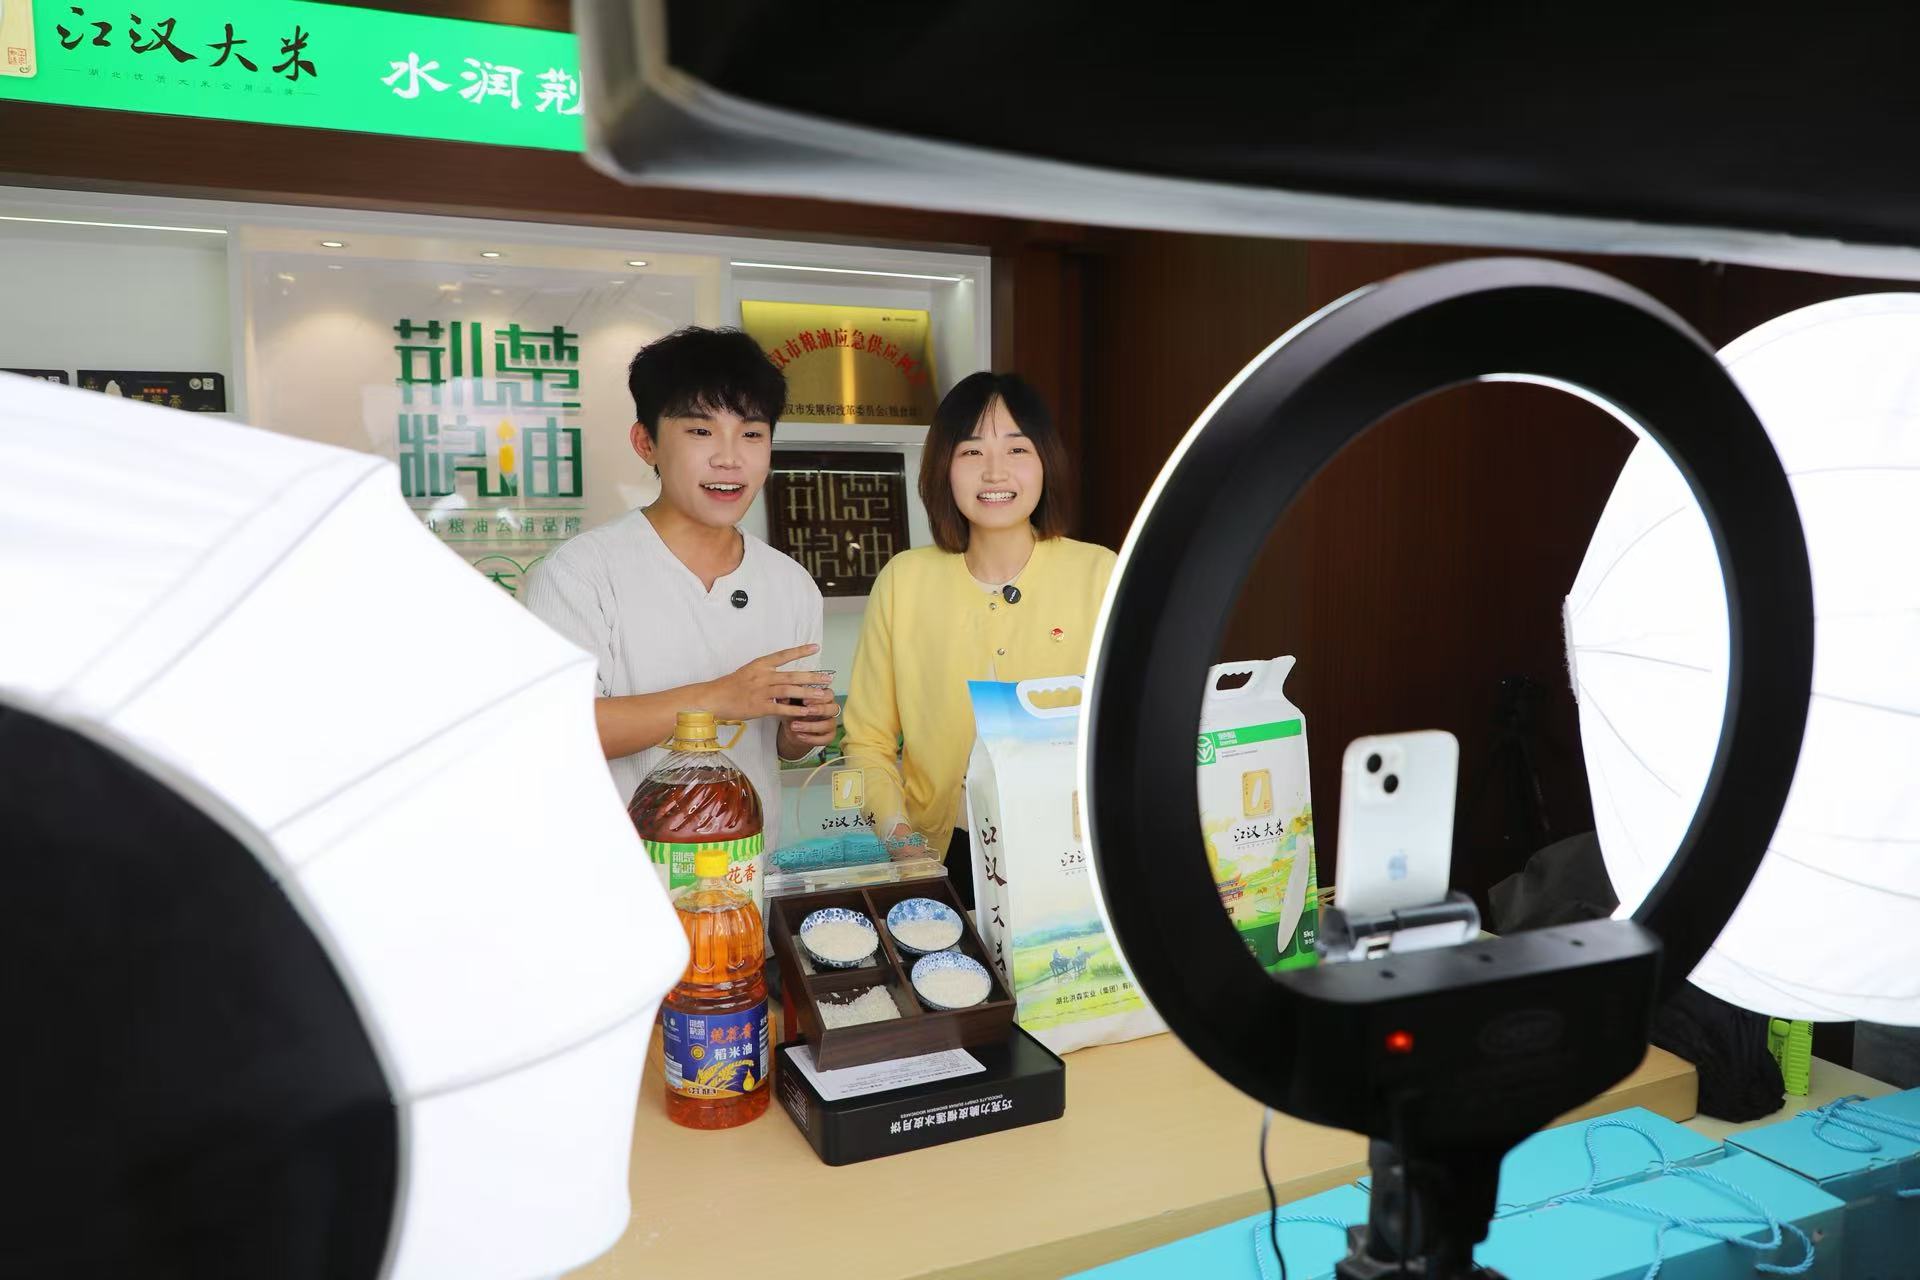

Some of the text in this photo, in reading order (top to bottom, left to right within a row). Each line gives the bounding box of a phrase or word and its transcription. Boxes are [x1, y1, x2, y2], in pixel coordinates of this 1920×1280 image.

[56, 6, 318, 81] 江汉大米
[822, 811, 876, 830] 江汉大米
[1234, 819, 1284, 842] 江汉大米
[714, 1043, 753, 1061] 稻米油
[890, 1099, 1013, 1134] 巧克力脆皮榴莲冰皮月饼
